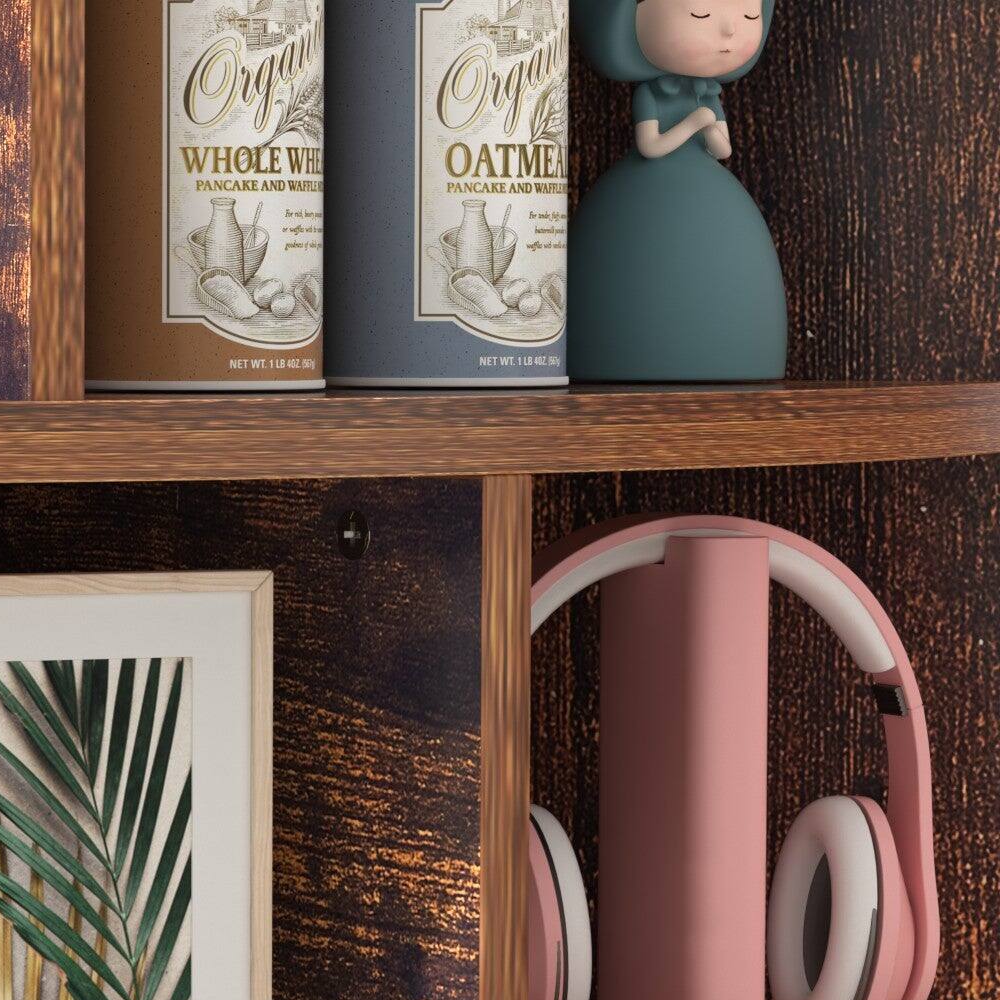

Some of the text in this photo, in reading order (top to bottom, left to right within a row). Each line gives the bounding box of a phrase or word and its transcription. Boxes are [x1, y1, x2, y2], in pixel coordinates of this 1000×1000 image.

[179, 146, 281, 174] WHOLE
[196, 180, 259, 192] PANCAKE
[261, 181, 286, 192] AND
[447, 182, 506, 194] PANCAKE
[509, 183, 532, 194] AND
[229, 359, 248, 369] NET
[251, 359, 267, 369] WT.
[269, 359, 273, 369] 1
[276, 359, 285, 369] LB
[479, 356, 497, 366] NET
[500, 356, 515, 366] WT.
[518, 356, 522, 366] 1
[524, 356, 533, 366] LB
